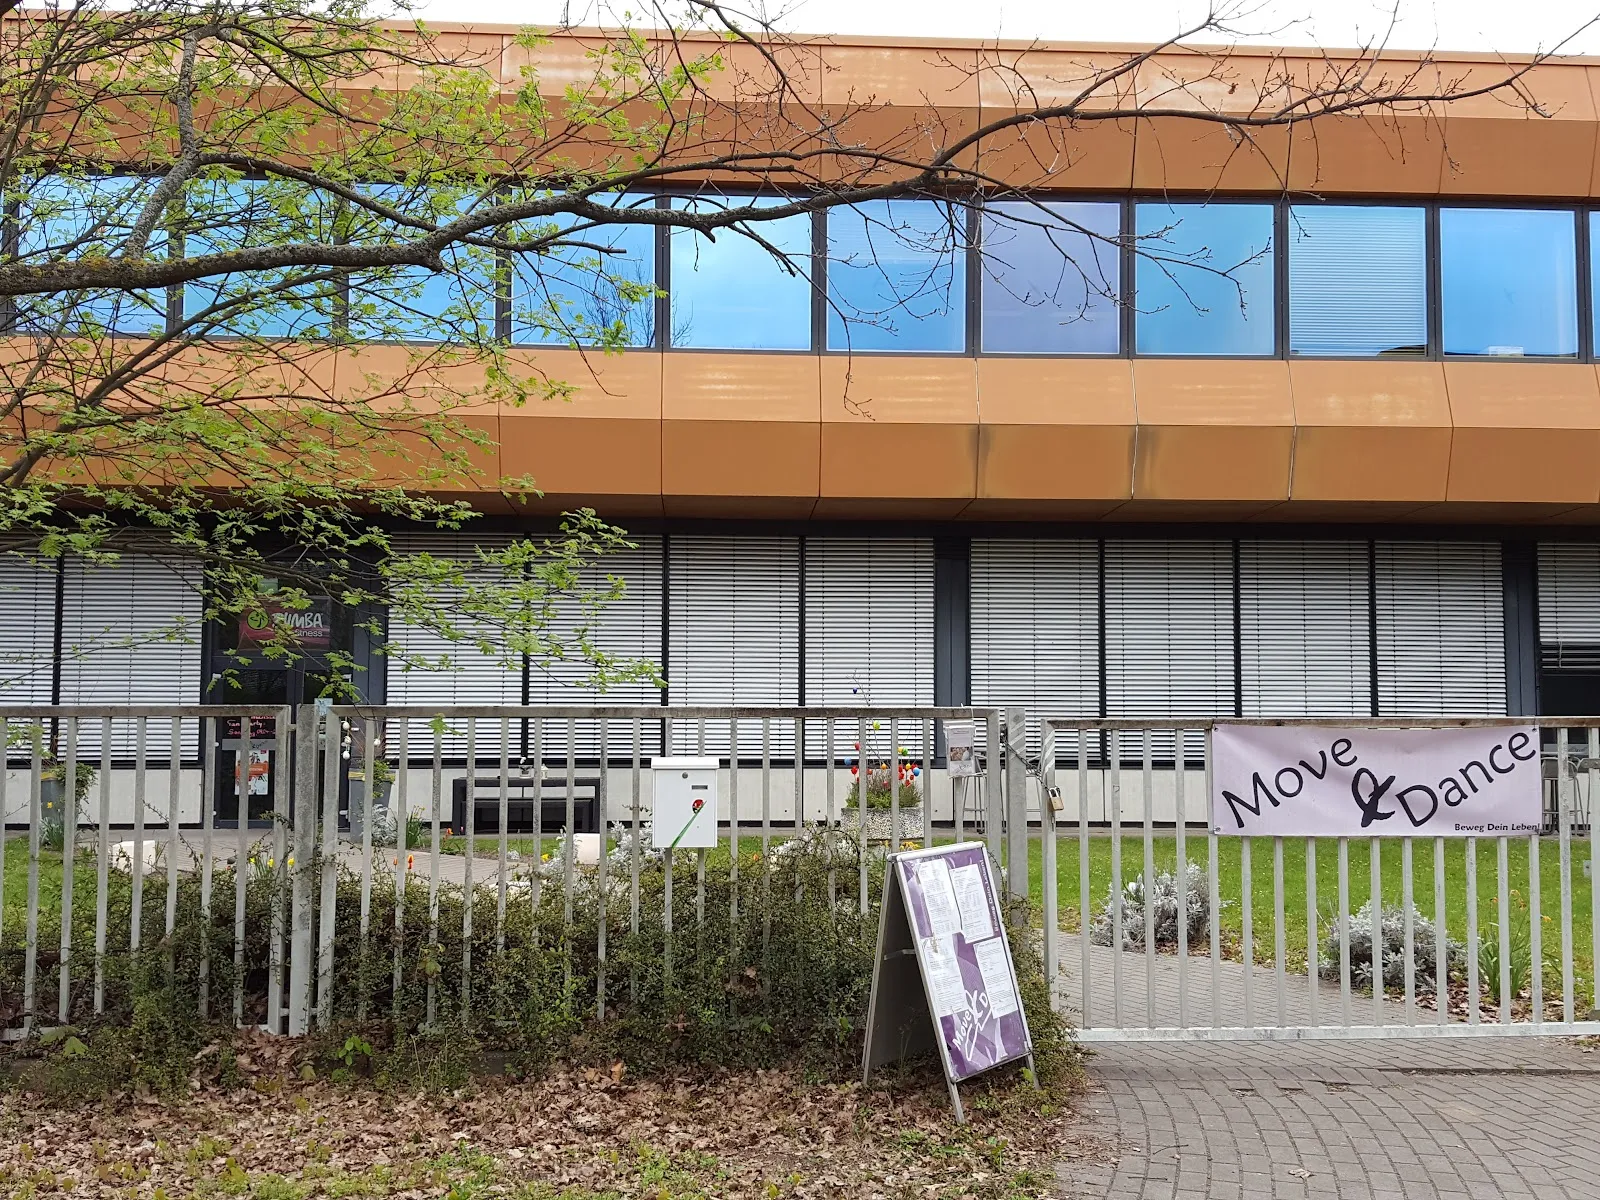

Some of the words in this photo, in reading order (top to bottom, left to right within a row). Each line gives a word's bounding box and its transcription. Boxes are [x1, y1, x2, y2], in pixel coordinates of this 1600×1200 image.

[1221, 738, 1358, 828] Move
[1351, 767, 1396, 828] &
[1395, 732, 1537, 828] Dance
[1454, 823, 1485, 833] Beweg
[1487, 823, 1508, 831] Dein
[1511, 822, 1540, 831] Leben!
[952, 1010, 972, 1051] Move
